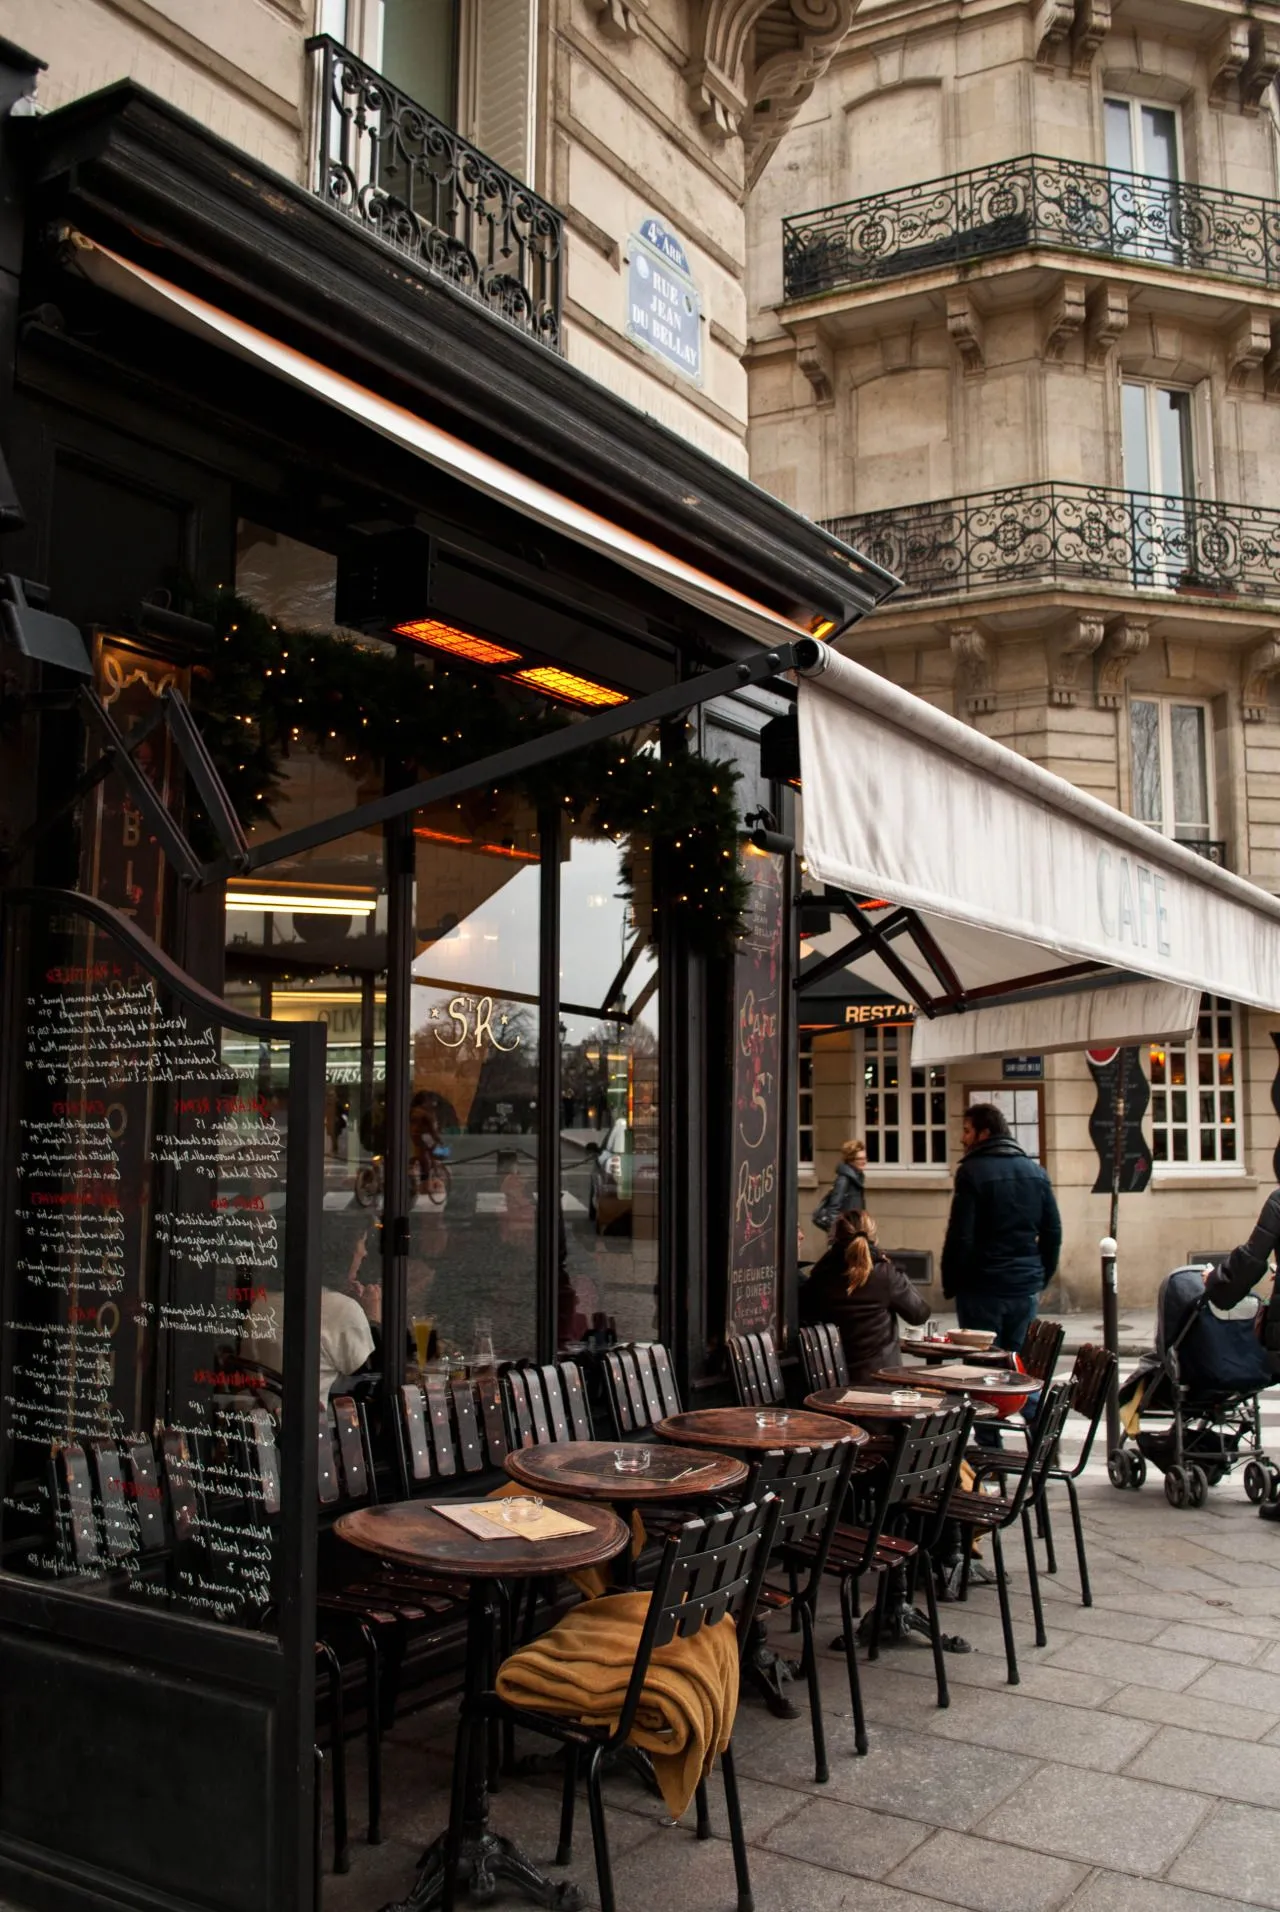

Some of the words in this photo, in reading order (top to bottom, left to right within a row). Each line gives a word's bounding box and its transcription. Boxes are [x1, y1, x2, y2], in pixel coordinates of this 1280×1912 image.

[653, 271, 678, 304] RUE
[651, 295, 682, 332] JEAN
[632, 304, 648, 330] DU
[653, 319, 697, 366] BELLAY
